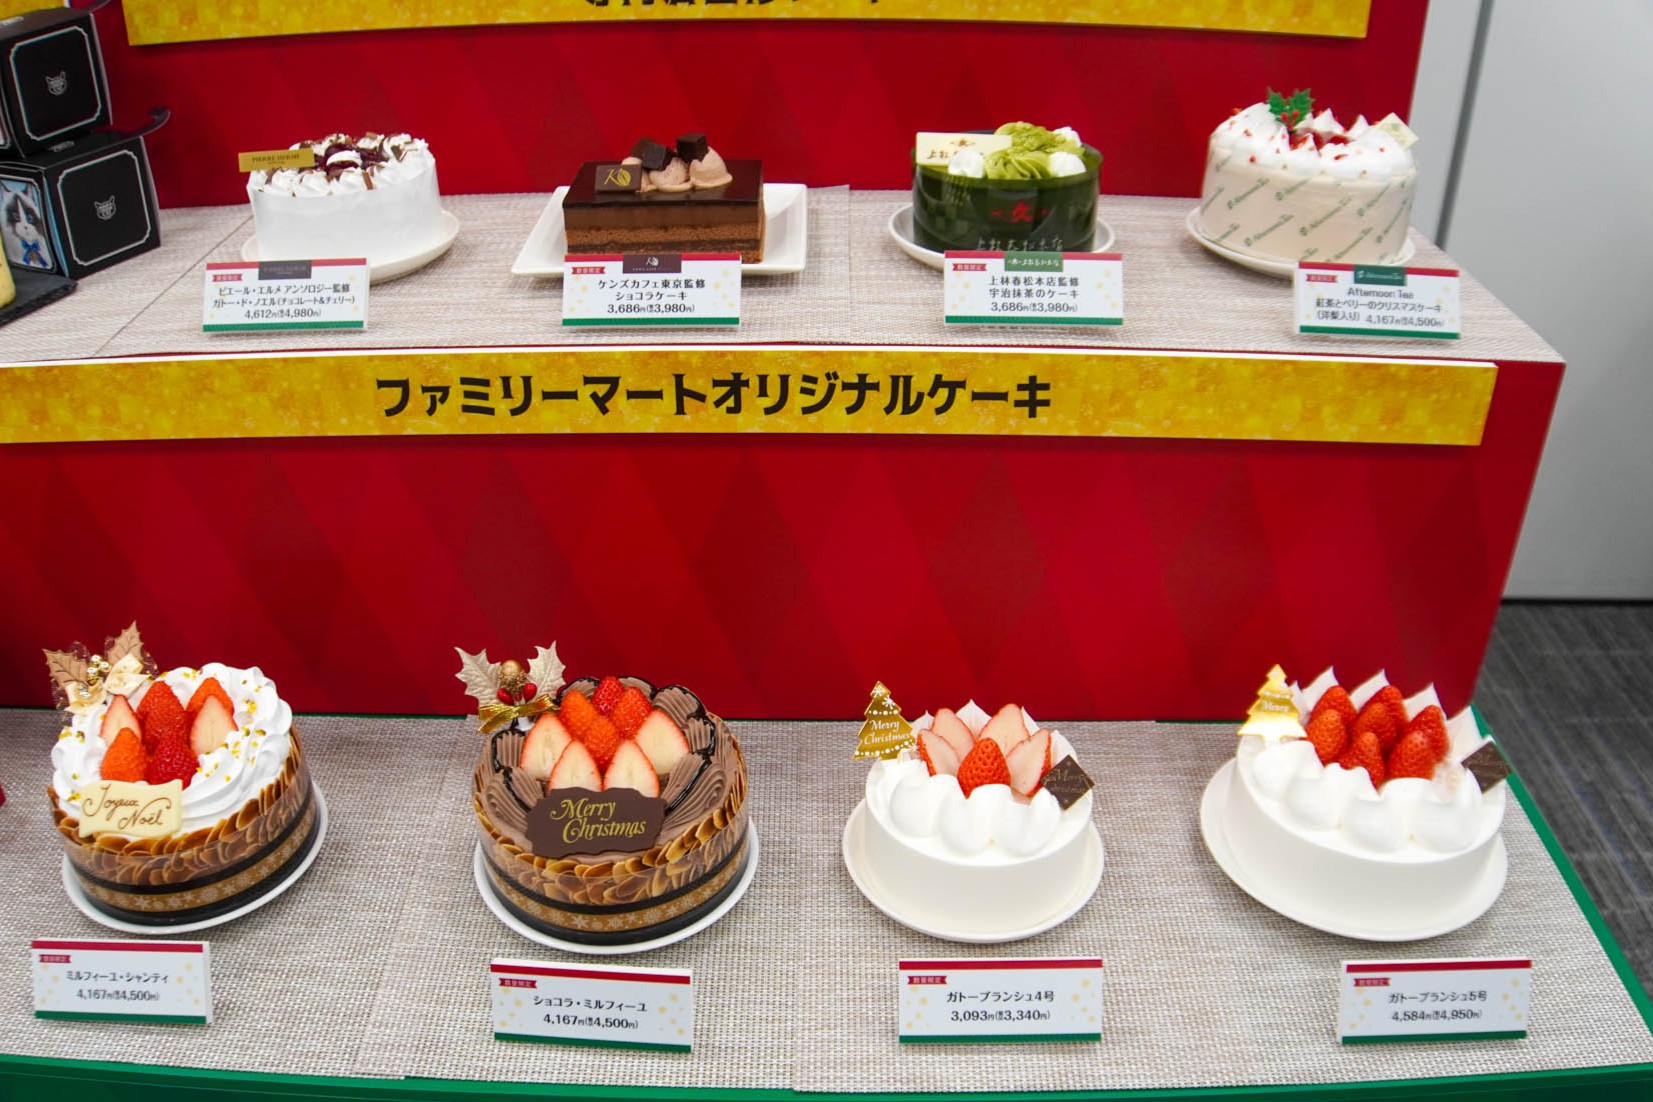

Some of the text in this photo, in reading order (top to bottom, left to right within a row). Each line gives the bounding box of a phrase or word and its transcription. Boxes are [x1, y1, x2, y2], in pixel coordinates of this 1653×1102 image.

[598, 278, 706, 289] ケンズカフェ東京監修
[988, 275, 1080, 286] 上林春松本店監修
[615, 291, 687, 301] ショコラケーキ
[988, 288, 1080, 299] 宇治抹茶のケーキ
[1347, 287, 1414, 299] Afternoon Tea
[375, 374, 1051, 419] ファミリーマートオリジナルケーキ
[869, 719, 900, 733] Merry
[82, 783, 139, 822] Joyeux
[549, 797, 616, 822] Merry
[117, 797, 172, 830] Noël
[562, 817, 647, 844] Christmas
[66, 970, 169, 983] ミルフィーユ・シャンティ
[533, 995, 648, 1012] ショコラ・ミルフィーユ
[946, 990, 1055, 1003] ガトーブランシュ4号
[1388, 990, 1488, 1004] ガトーブランシュ5号
